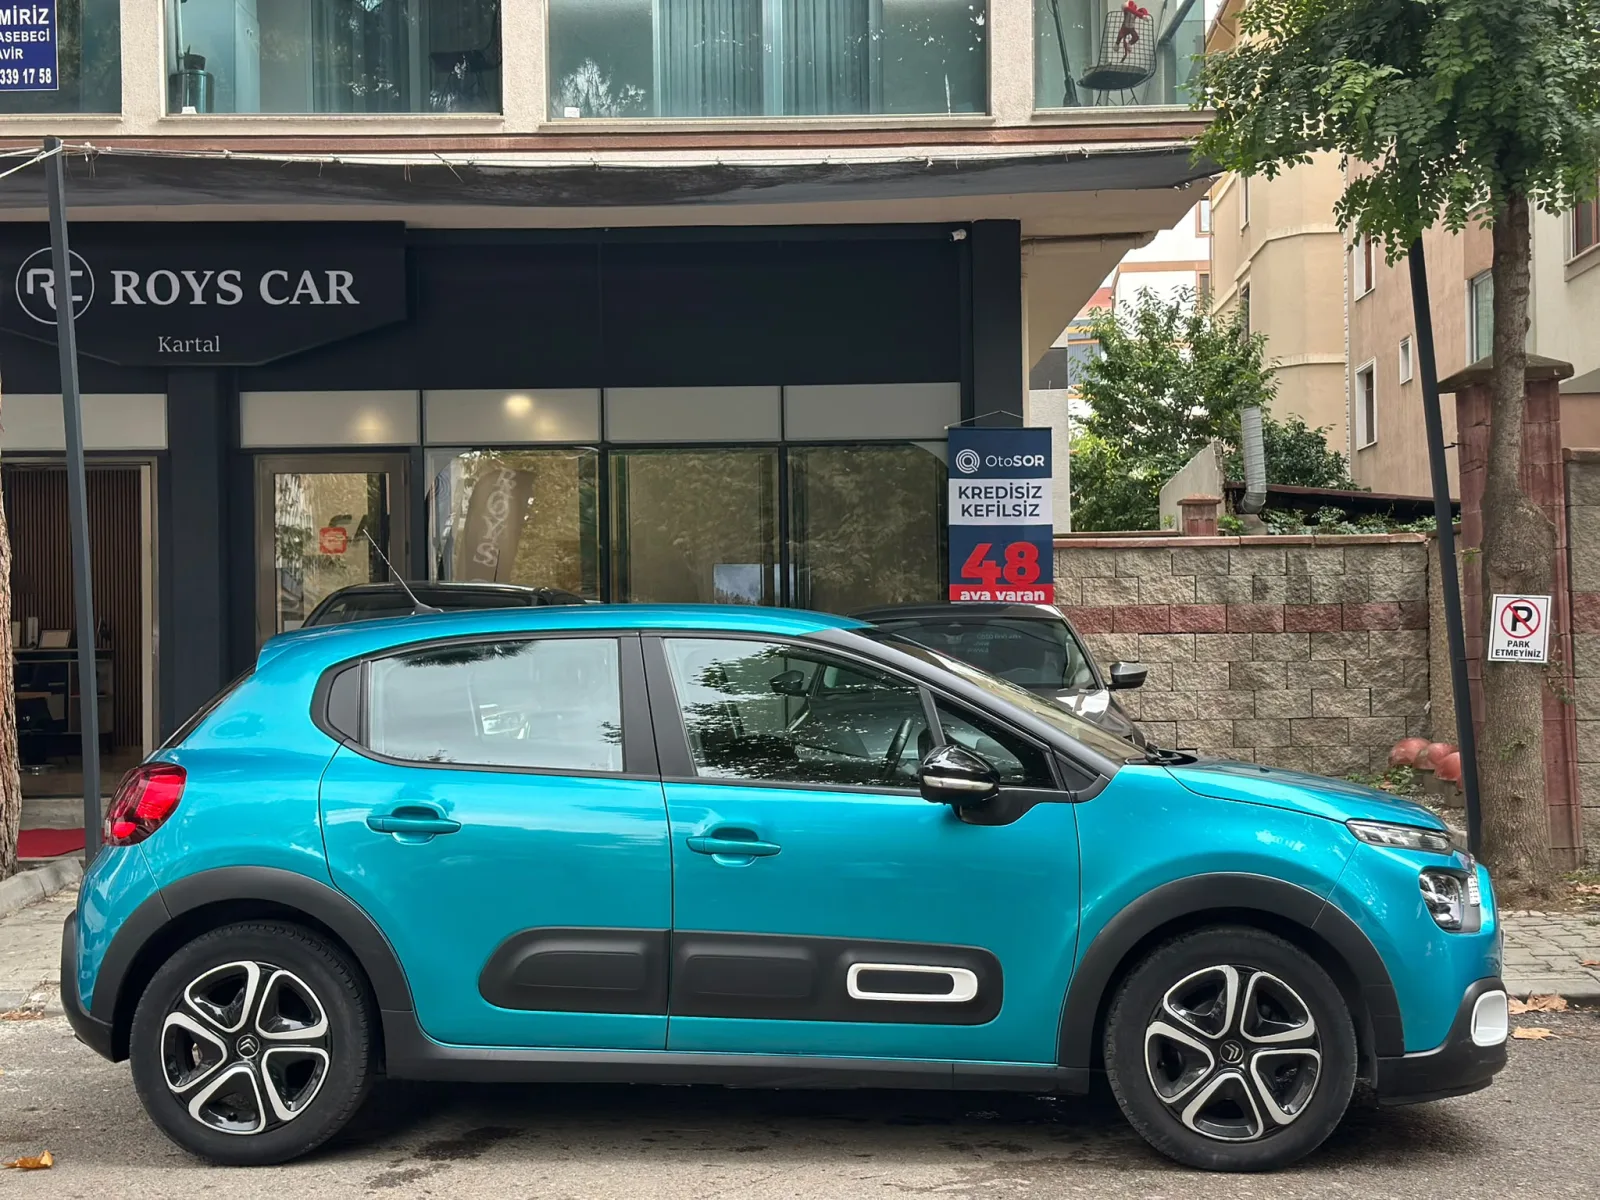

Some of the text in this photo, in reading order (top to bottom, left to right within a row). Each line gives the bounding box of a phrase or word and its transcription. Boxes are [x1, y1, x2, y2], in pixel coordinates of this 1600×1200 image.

[0, 68, 52, 85] 339 17 58
[110, 269, 361, 306] ROYS CAR
[158, 335, 220, 353] Kartal
[985, 454, 1045, 468] OtoSOR
[958, 482, 1043, 500] KREDİSİZ
[961, 500, 1040, 518] KEFİLSİZ
[961, 541, 1041, 586] 48
[1495, 648, 1542, 658] ETMEYİNİZ
[1507, 640, 1531, 648] PARK
